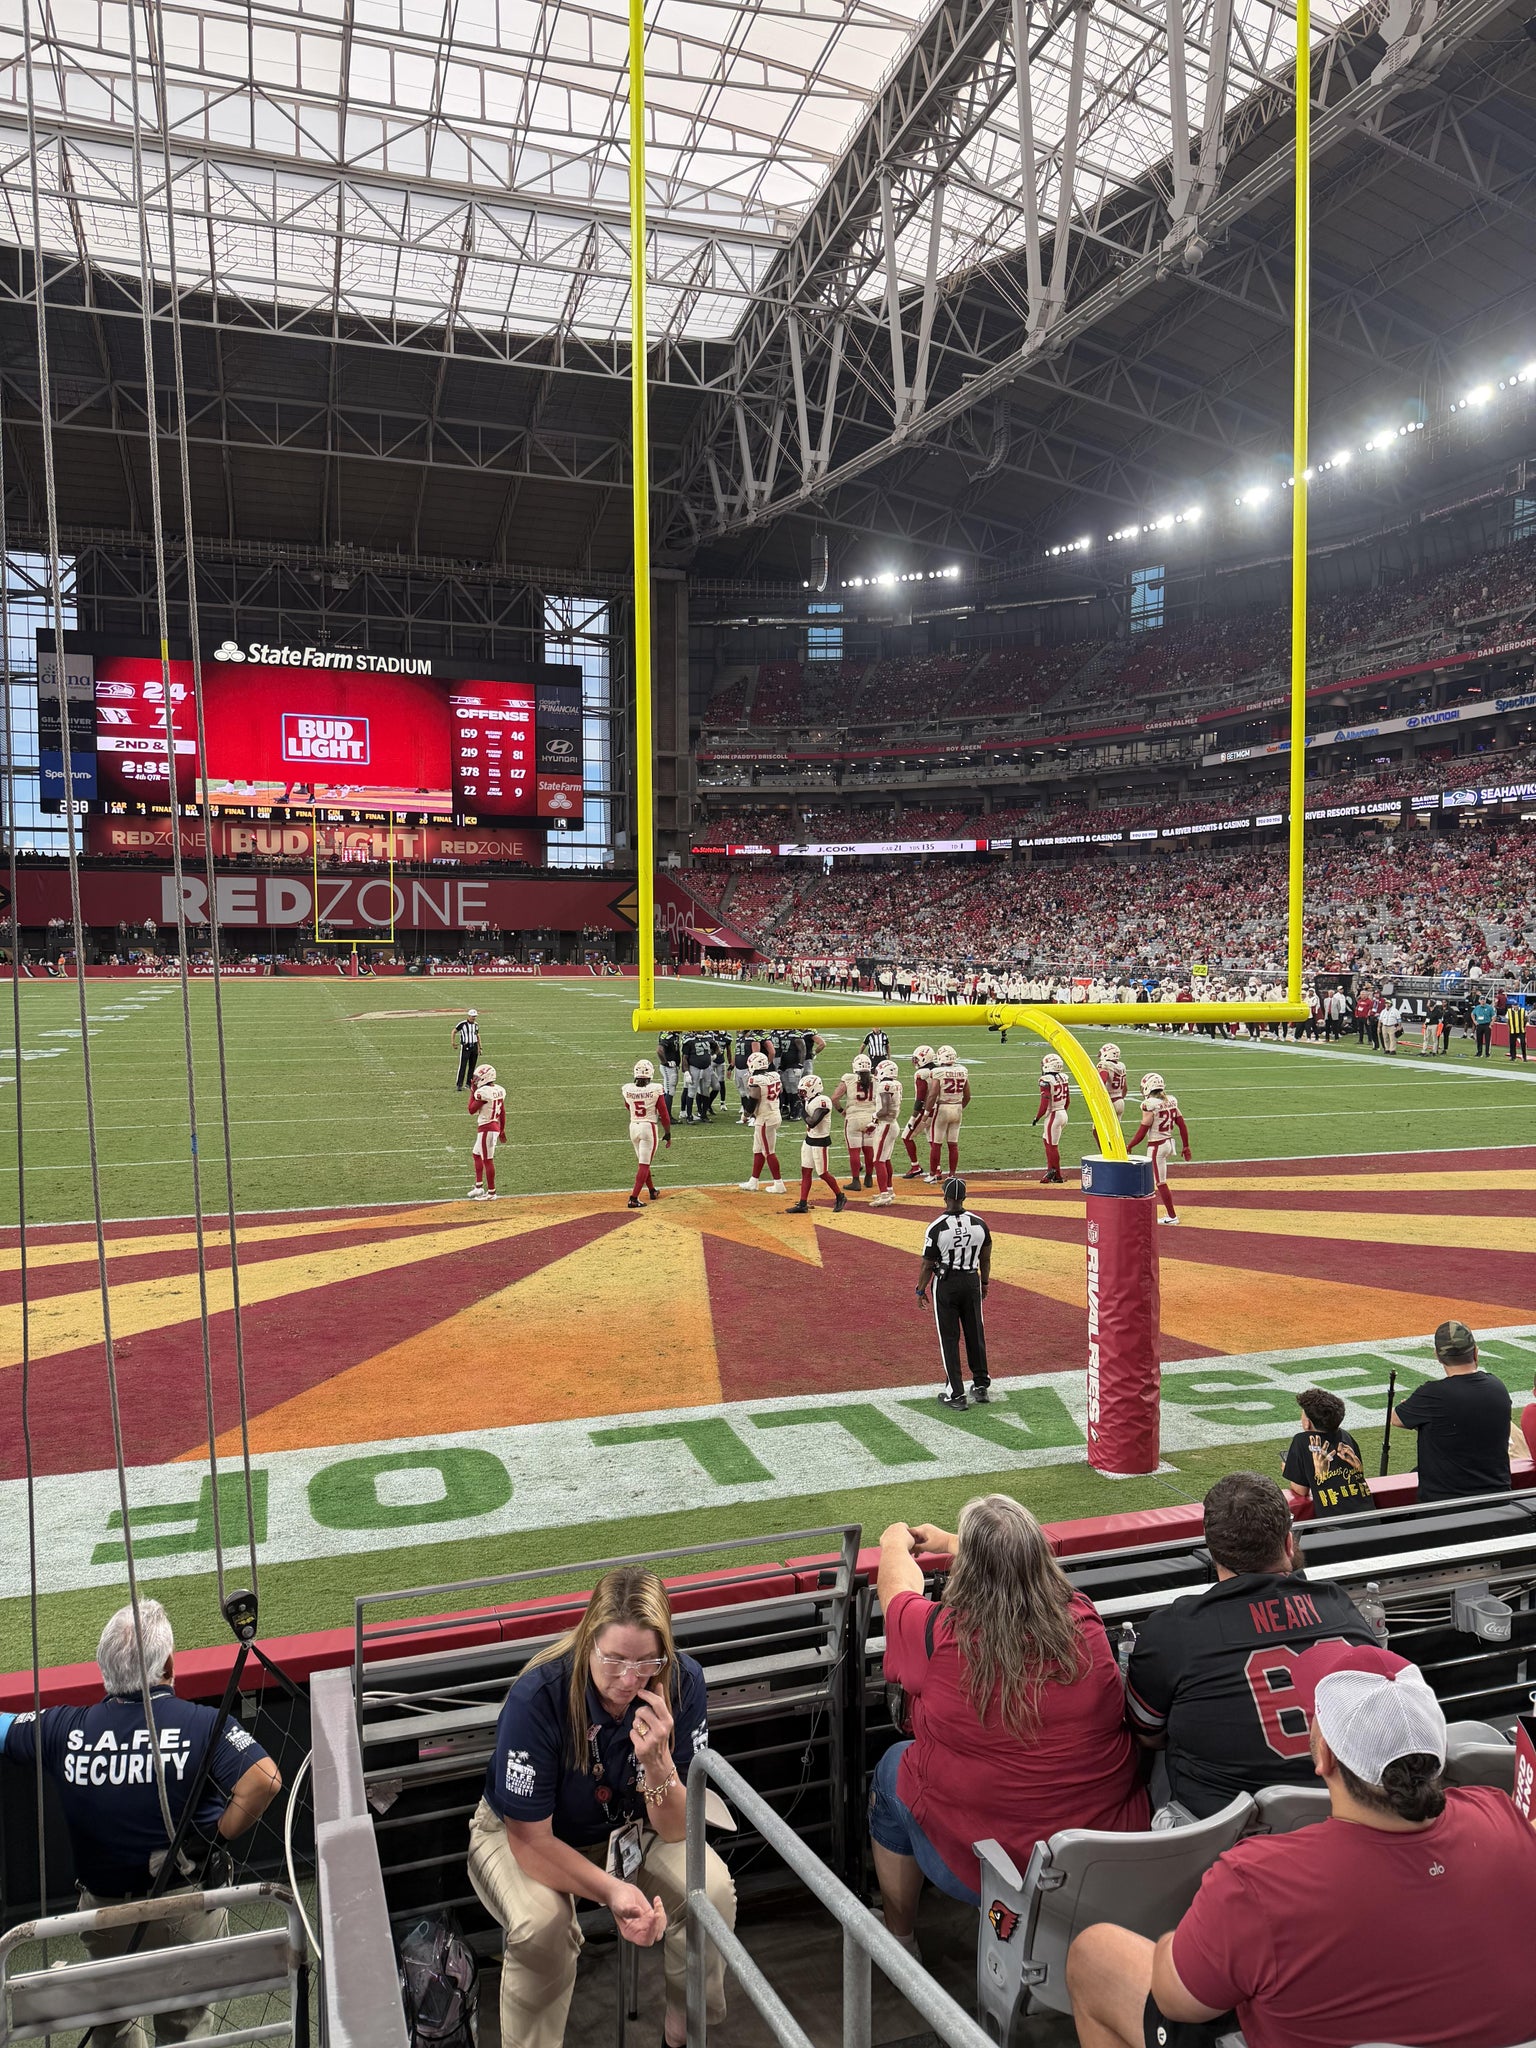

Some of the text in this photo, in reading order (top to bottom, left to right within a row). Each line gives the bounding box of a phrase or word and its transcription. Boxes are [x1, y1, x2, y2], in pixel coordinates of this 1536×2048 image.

[1477, 647, 1494, 658] DAN
[356, 654, 432, 676] STADIUM
[41, 671, 91, 686] cina
[143, 681, 188, 700] 24
[1246, 697, 1285, 711] ERNIE NEVERS
[155, 708, 175, 724] 7
[456, 708, 530, 722] OFFENSE
[1421, 710, 1460, 724] HYUNDAI
[298, 719, 354, 741] BUD
[1145, 720, 1172, 730] CARSON
[460, 728, 478, 739] 159
[511, 731, 526, 742] 46
[115, 740, 148, 750] 2ND
[152, 742, 165, 751] &
[287, 737, 365, 760] LIGHT
[461, 747, 478, 758] 219
[512, 750, 524, 760] 81
[542, 754, 578, 763] HYUNDAI
[1227, 750, 1250, 760] BETMGM
[45, 768, 89, 779] Specrum
[121, 760, 171, 773] 2:38
[460, 766, 480, 777] 378
[510, 768, 526, 779] 127
[464, 785, 477, 796] 22
[514, 787, 523, 798] 9
[59, 799, 88, 813] 238
[111, 801, 128, 809] CAR
[152, 805, 173, 813] FINAL
[1305, 810, 1326, 821] RIVER
[1327, 804, 1359, 819] RESORTS
[1361, 806, 1366, 814] &
[1367, 801, 1401, 814] CASINOS
[365, 813, 385, 821] FINAL
[1175, 827, 1191, 836] RIVER
[1192, 824, 1217, 834] RESORTS
[1223, 819, 1250, 829] CASINOS
[111, 830, 206, 847] REDZONE
[231, 828, 309, 855] BUD
[1018, 839, 1033, 847] GILA
[1034, 838, 1053, 846] RIVER
[1054, 835, 1084, 845] RESORTS
[1092, 833, 1122, 842] CASINOS
[441, 840, 523, 856] REDZONE
[817, 845, 856, 853] J.COOK
[922, 843, 935, 851] 135
[161, 874, 490, 926] REDZONE
[434, 966, 533, 974] RIZON CARDINALS
[634, 1100, 647, 1117] 5
[955, 1227, 968, 1235] BJ
[953, 1234, 971, 1248] 27
[1087, 1246, 1100, 1424] RIVALRIES
[90, 1447, 514, 1566] OF
[1249, 1593, 1323, 1634] NEARY
[67, 1728, 191, 1751] S.A.F.E.
[64, 1751, 190, 1786] SECURITY
[1521, 1762, 1534, 1818] ANG
[1429, 1862, 1445, 1876] alo
